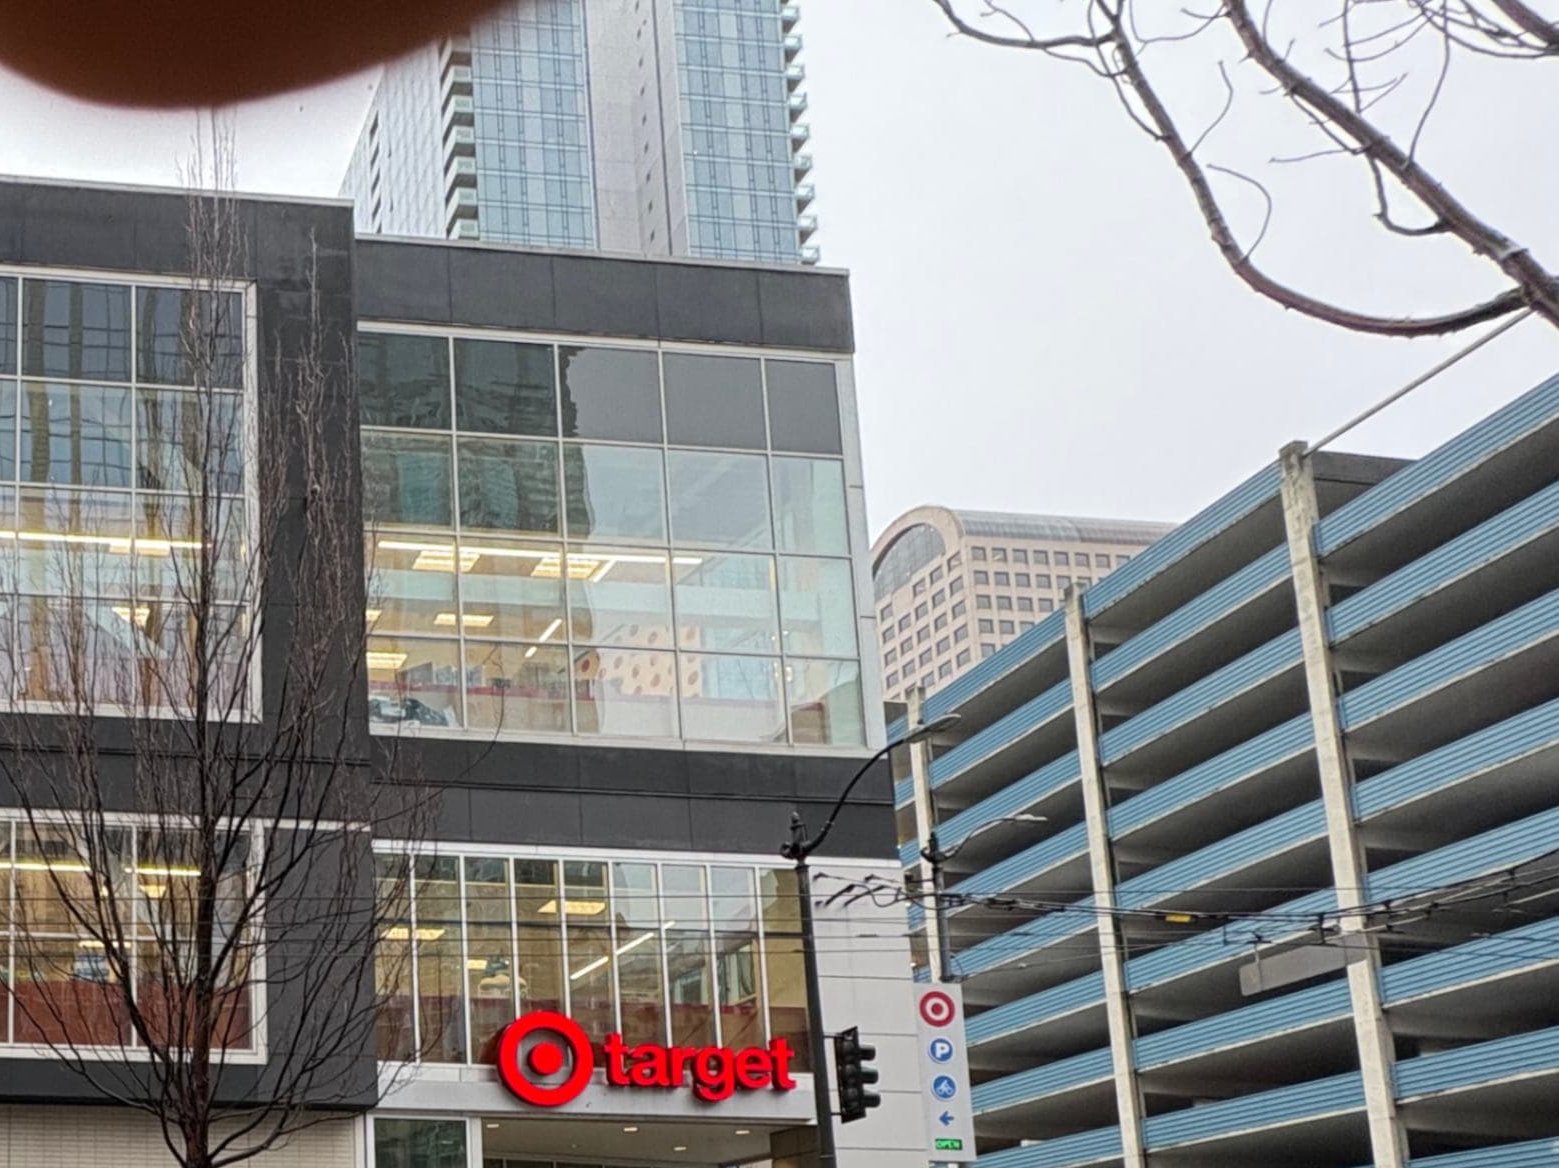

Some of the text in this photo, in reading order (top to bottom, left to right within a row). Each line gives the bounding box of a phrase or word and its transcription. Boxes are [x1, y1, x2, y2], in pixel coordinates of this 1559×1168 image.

[936, 1042, 950, 1058] P
[604, 1032, 796, 1102] target
[936, 1139, 961, 1150] OPEN
